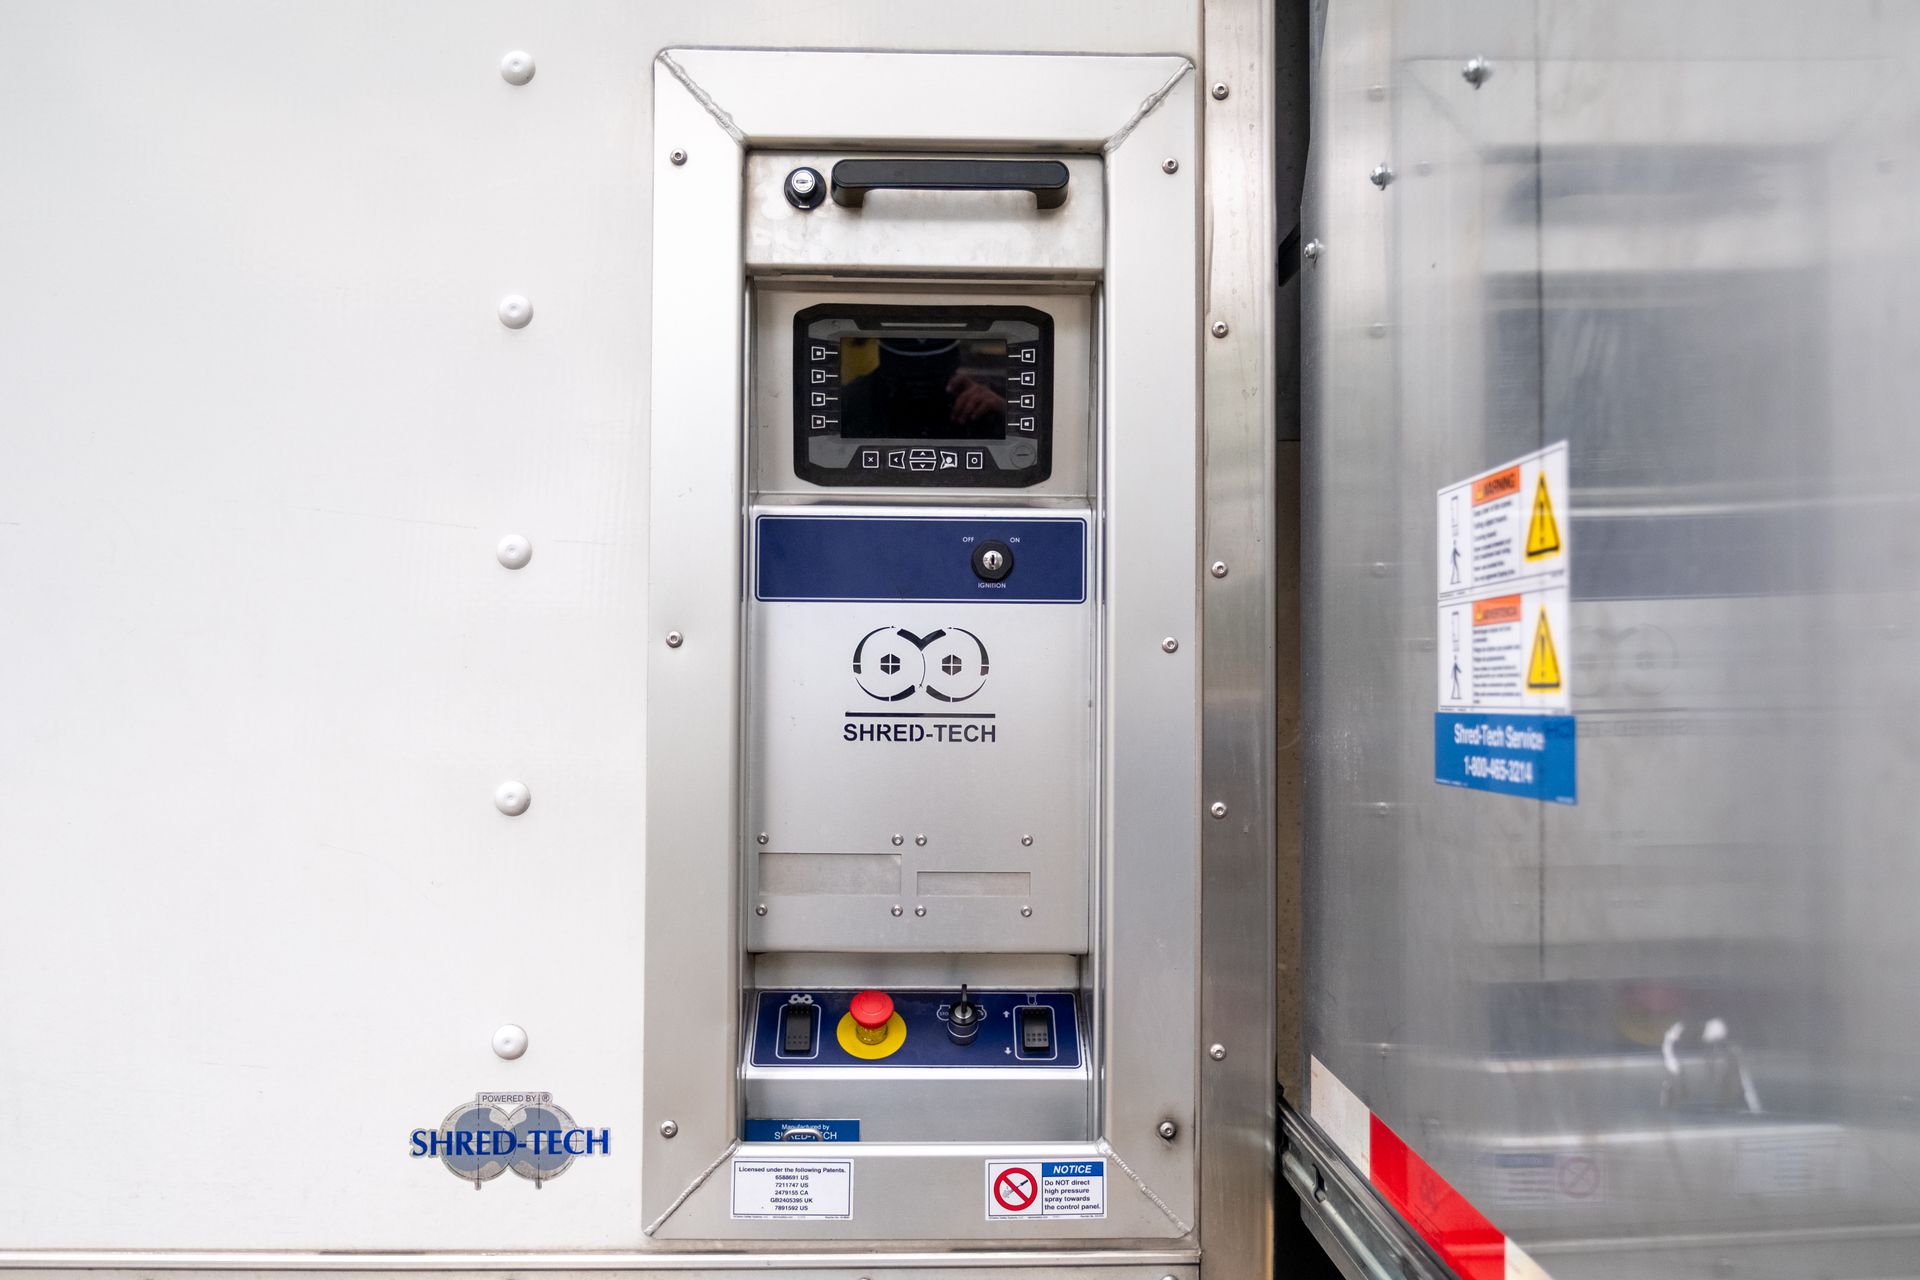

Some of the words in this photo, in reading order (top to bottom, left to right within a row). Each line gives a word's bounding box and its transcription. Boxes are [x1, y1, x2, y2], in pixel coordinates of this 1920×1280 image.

[843, 723, 996, 743] SHRED-TECH
[1453, 722, 1505, 747] Shred-Tech
[1505, 724, 1546, 752] Service
[482, 1094, 524, 1103] POWERED
[525, 1094, 537, 1103] BY
[822, 1123, 830, 1131] by
[411, 1129, 610, 1157] SHRED-TECH
[1053, 1165, 1092, 1174] NOTICE
